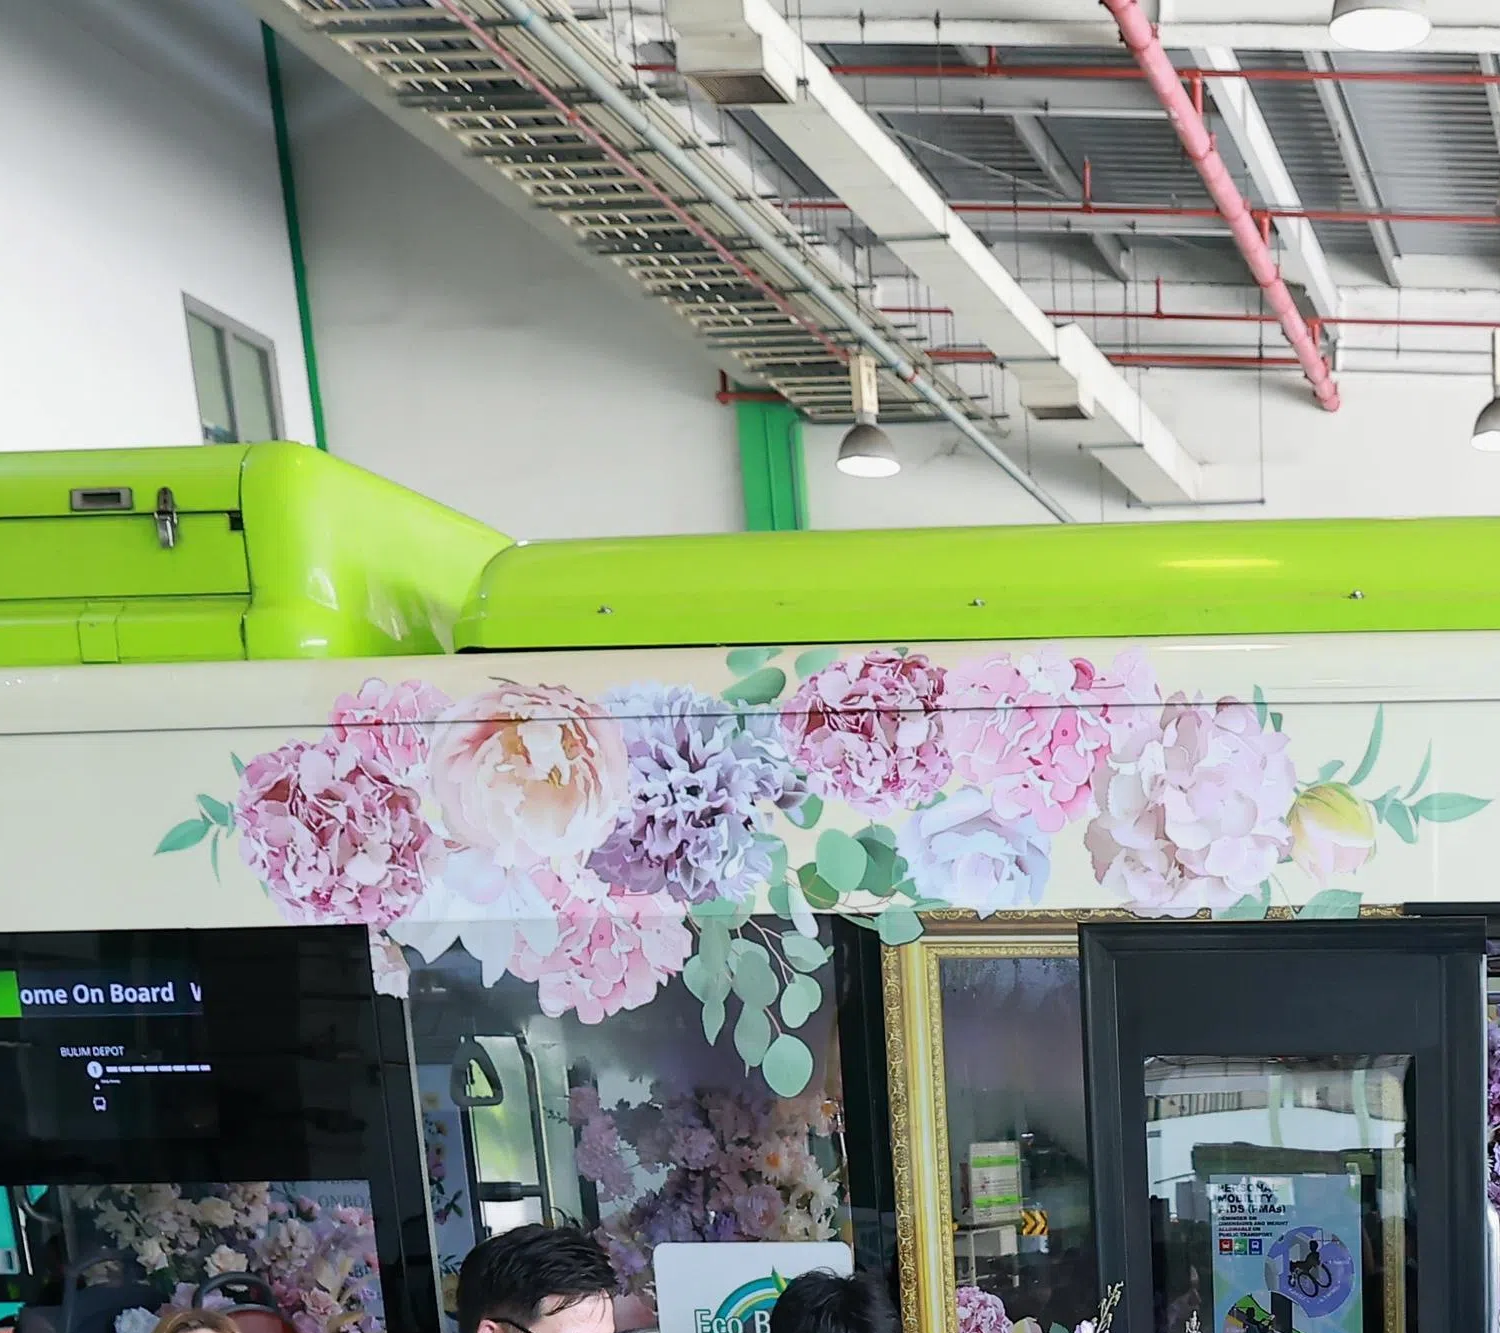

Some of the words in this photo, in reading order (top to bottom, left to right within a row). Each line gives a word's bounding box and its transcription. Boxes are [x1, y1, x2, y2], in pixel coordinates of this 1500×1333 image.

[73, 984, 104, 1003] On
[109, 982, 174, 1004] Board
[93, 1046, 125, 1056] DEPOT
